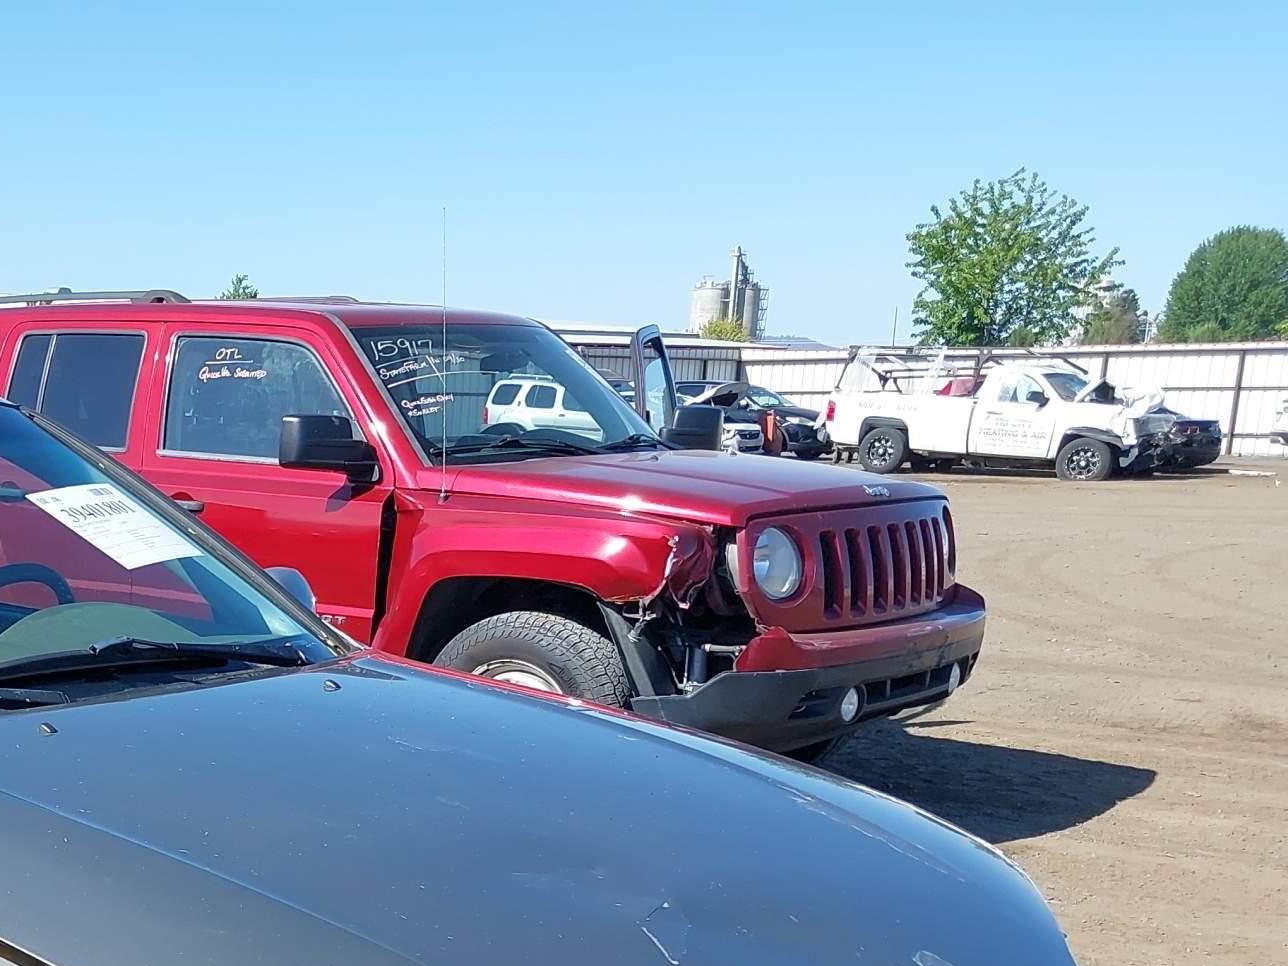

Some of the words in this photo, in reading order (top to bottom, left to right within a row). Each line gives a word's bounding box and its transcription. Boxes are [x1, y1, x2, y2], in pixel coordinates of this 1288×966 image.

[215, 347, 243, 361] OTL
[370, 338, 433, 361] 15917
[60, 499, 137, 523] 39401801
